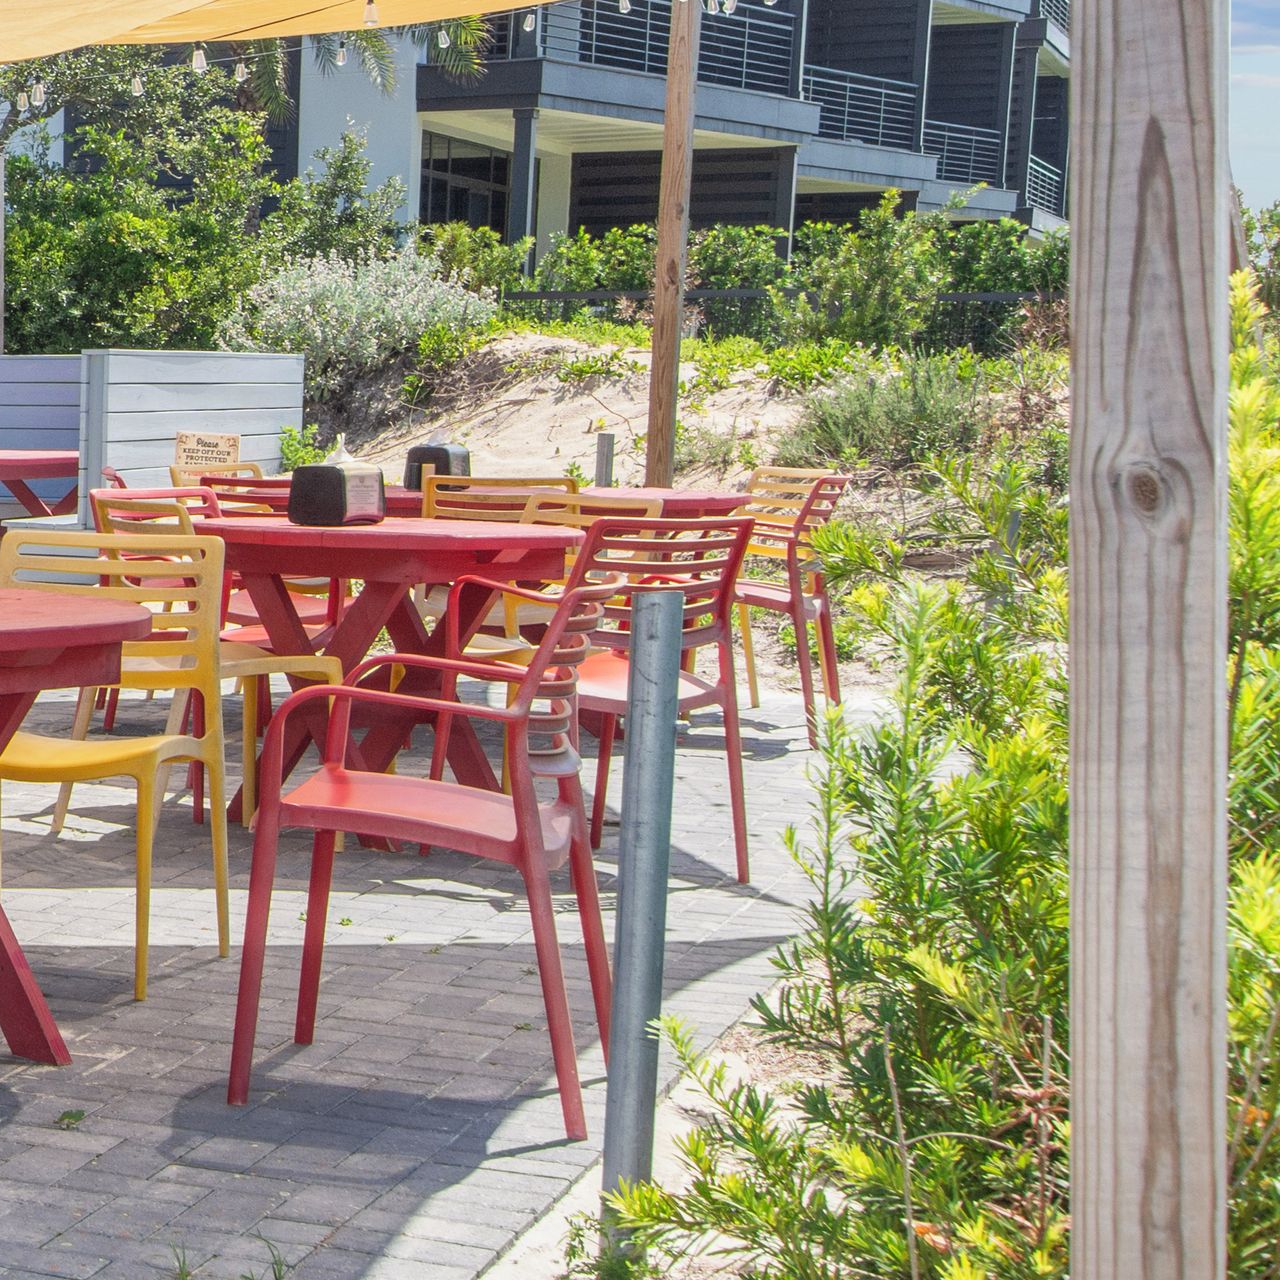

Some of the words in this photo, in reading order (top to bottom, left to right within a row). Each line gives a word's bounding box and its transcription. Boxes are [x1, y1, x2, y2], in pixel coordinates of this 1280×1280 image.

[196, 437, 219, 449] Please
[183, 447, 200, 455] KEEP
[185, 454, 228, 463] PROTECTED
